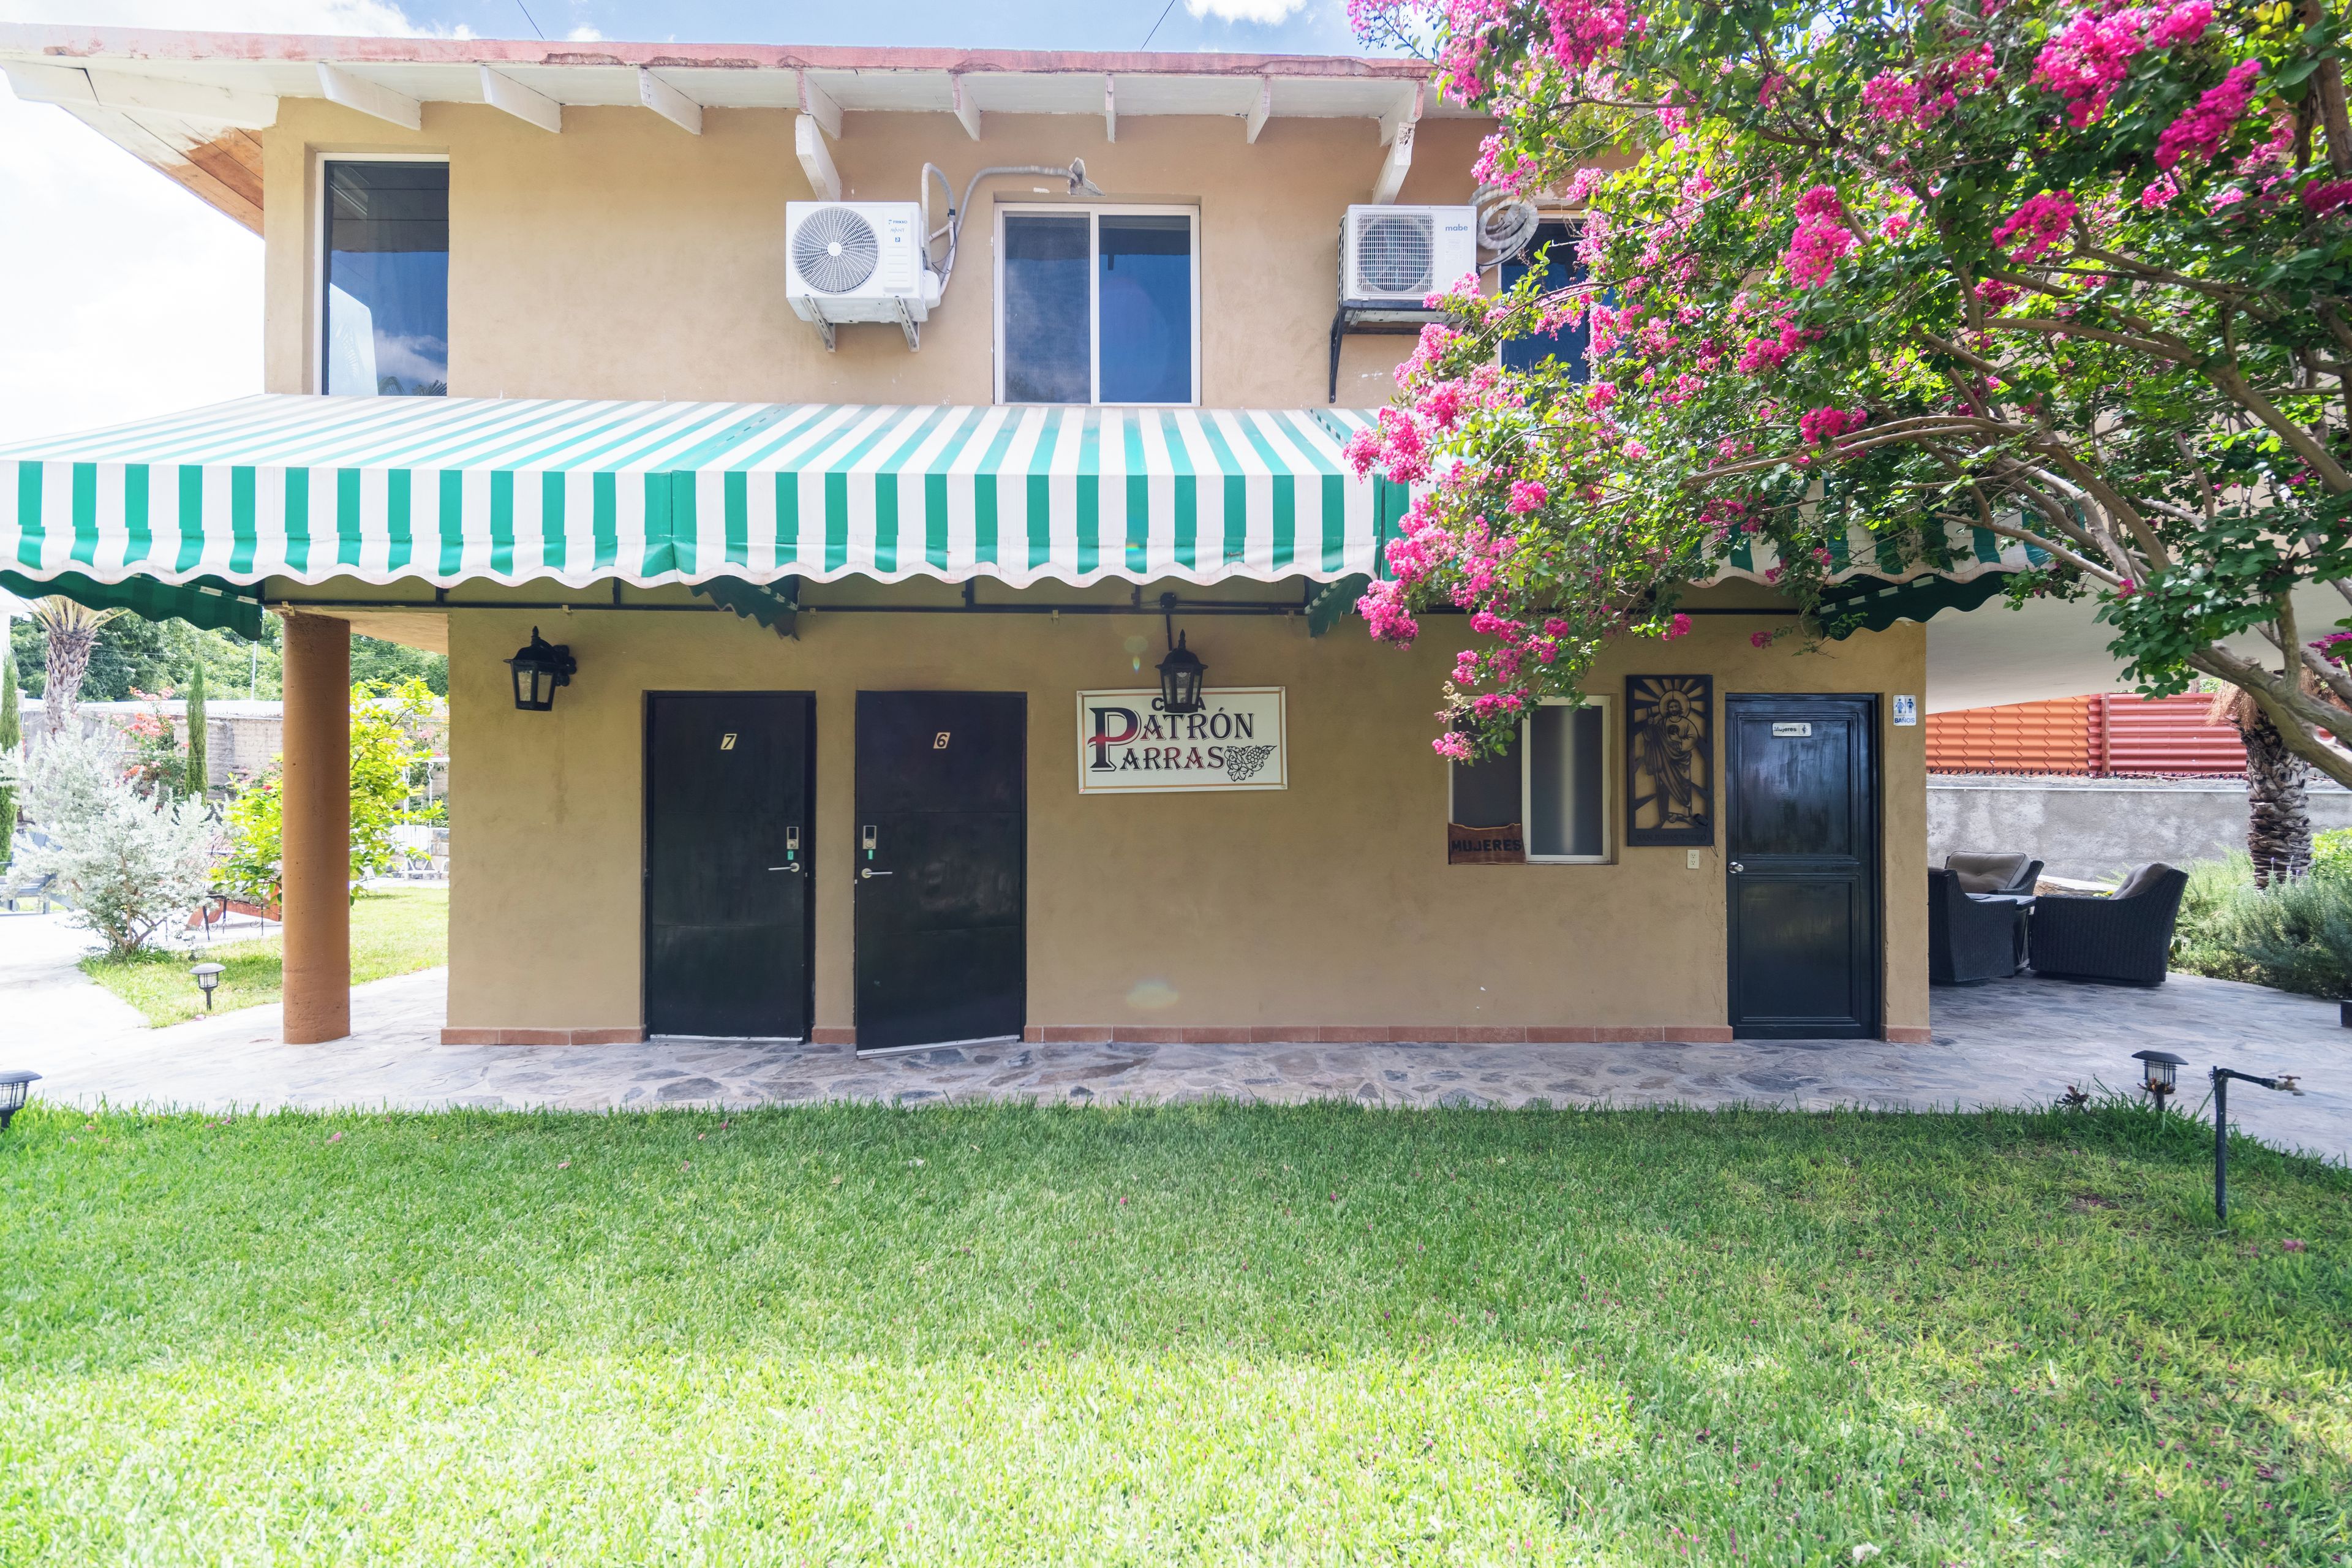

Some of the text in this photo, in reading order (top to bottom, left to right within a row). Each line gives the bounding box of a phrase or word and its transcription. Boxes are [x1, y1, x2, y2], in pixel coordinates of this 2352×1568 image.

[1152, 697, 1206, 711] CA
[722, 734, 736, 749] 7
[936, 733, 949, 748] 6
[1088, 707, 1254, 772] PATRÓN
[1452, 839, 1522, 852] MUJERES
